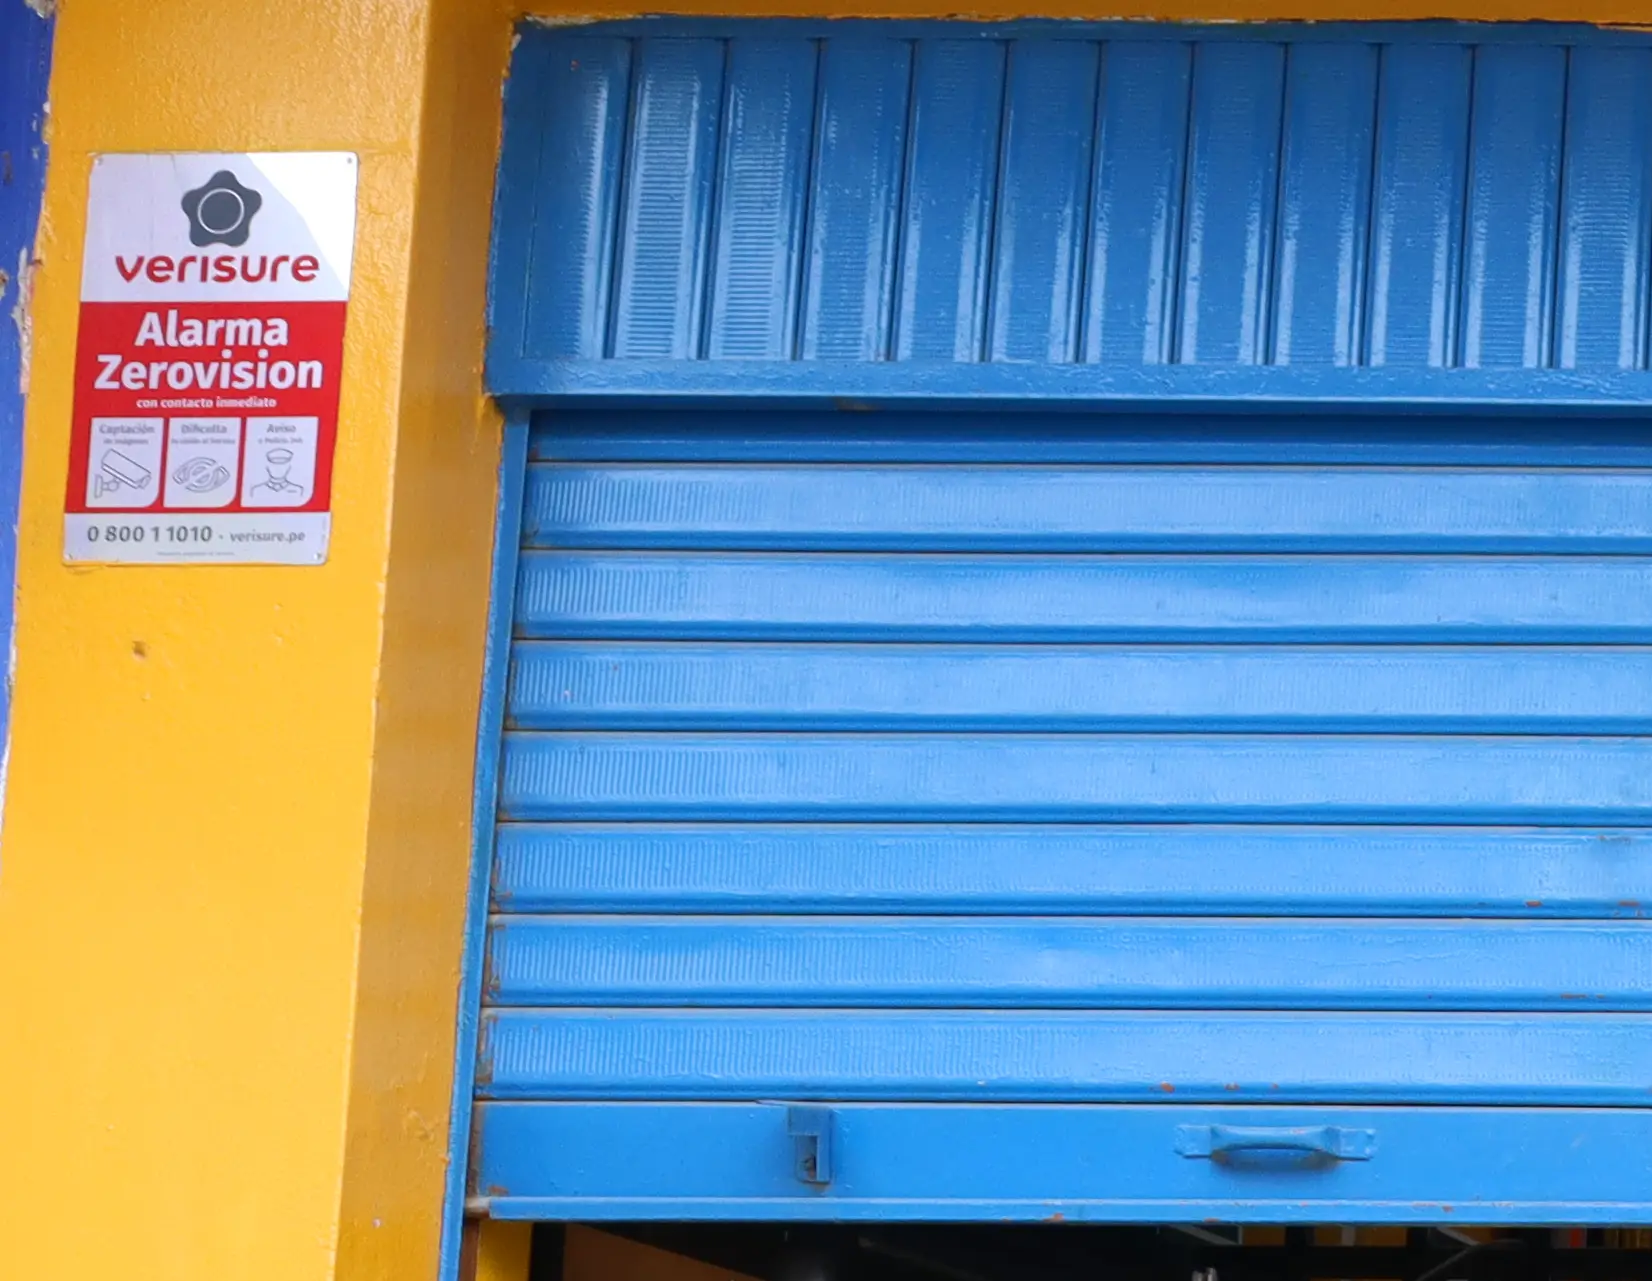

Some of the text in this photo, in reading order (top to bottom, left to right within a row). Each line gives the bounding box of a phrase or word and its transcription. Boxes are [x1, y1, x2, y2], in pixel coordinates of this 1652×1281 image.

[115, 253, 320, 283] verisure
[134, 310, 289, 347] Alarma
[94, 349, 323, 390] Zerovision
[136, 396, 278, 409] con contacto inmediato
[266, 423, 297, 434] Aviso
[87, 525, 306, 545] 0 800 1 1010 verisure.pe
